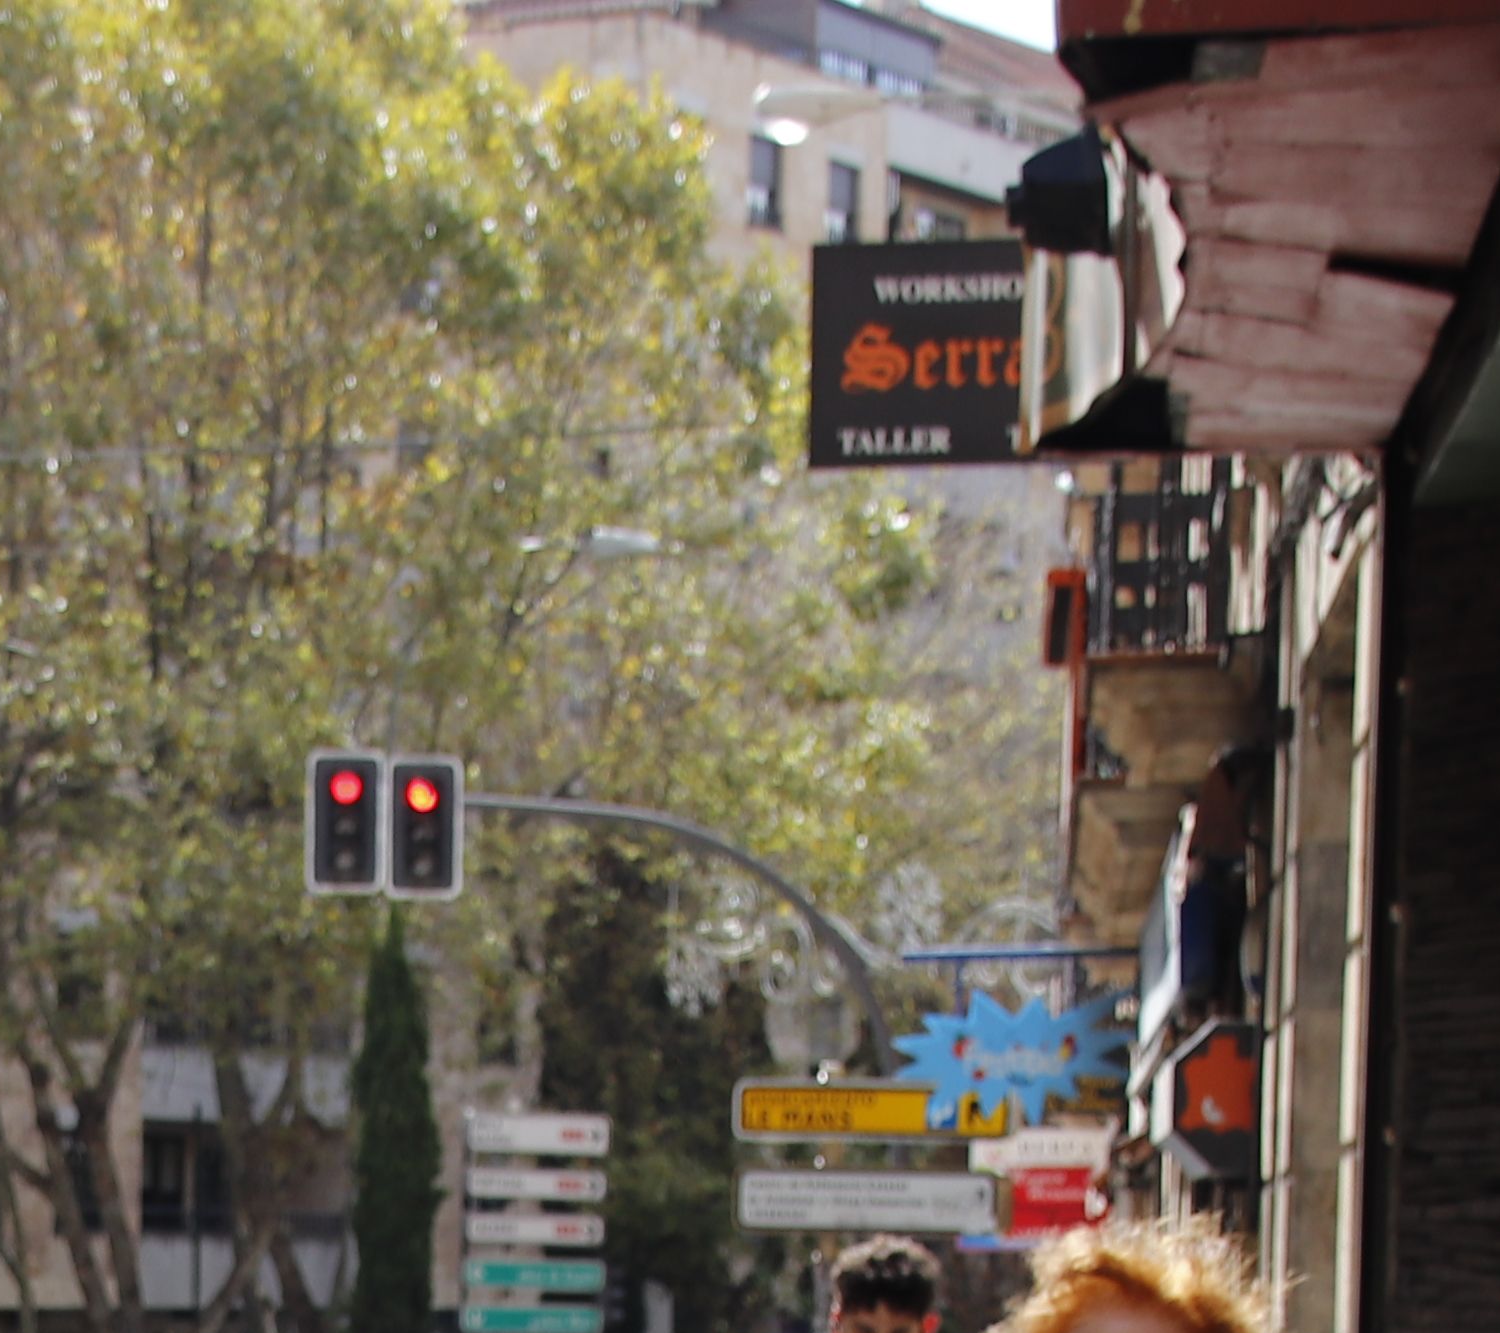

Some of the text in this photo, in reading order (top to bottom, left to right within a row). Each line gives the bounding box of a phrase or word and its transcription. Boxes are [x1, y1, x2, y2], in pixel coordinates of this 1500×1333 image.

[873, 273, 1025, 304] WORKSHO
[841, 322, 1023, 394] Serra
[837, 426, 951, 456] TALLER
